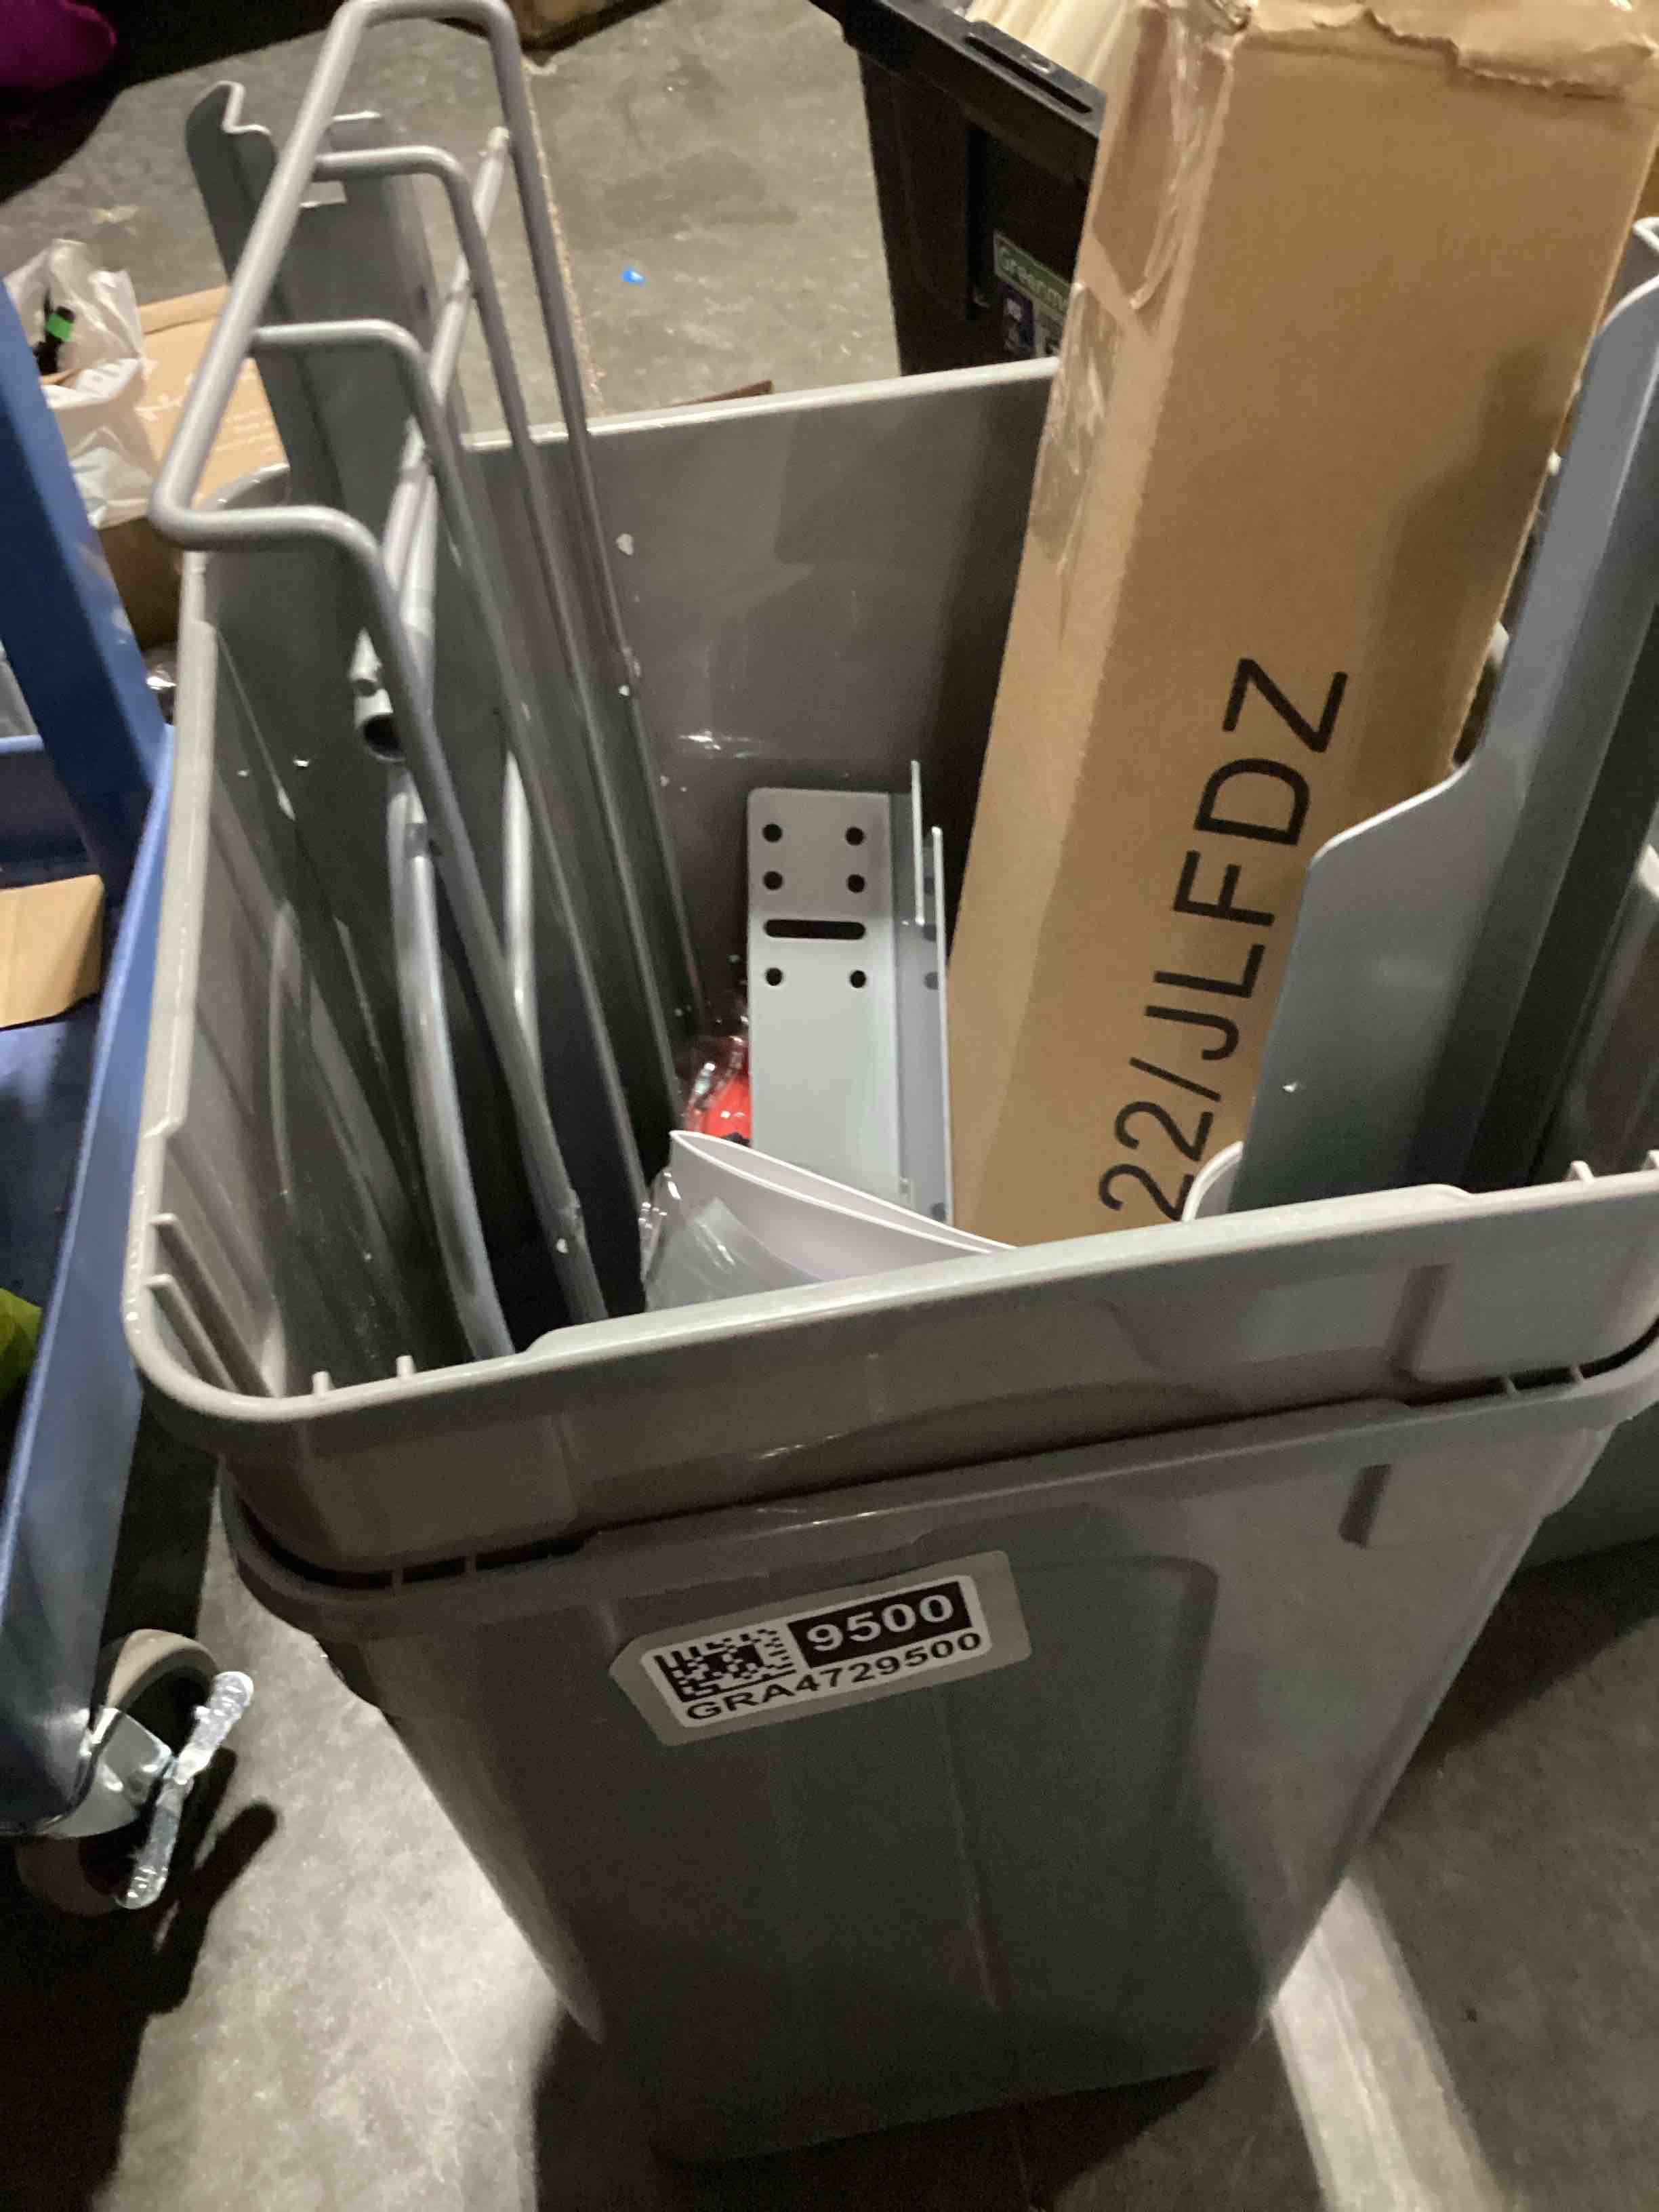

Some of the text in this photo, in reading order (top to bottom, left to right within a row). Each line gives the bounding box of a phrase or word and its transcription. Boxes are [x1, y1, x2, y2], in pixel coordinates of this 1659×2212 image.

[1099, 657, 1348, 1221] 22/JLFDZ
[806, 1594, 954, 1651] 9500
[686, 1631, 982, 1720] GRA4729500
